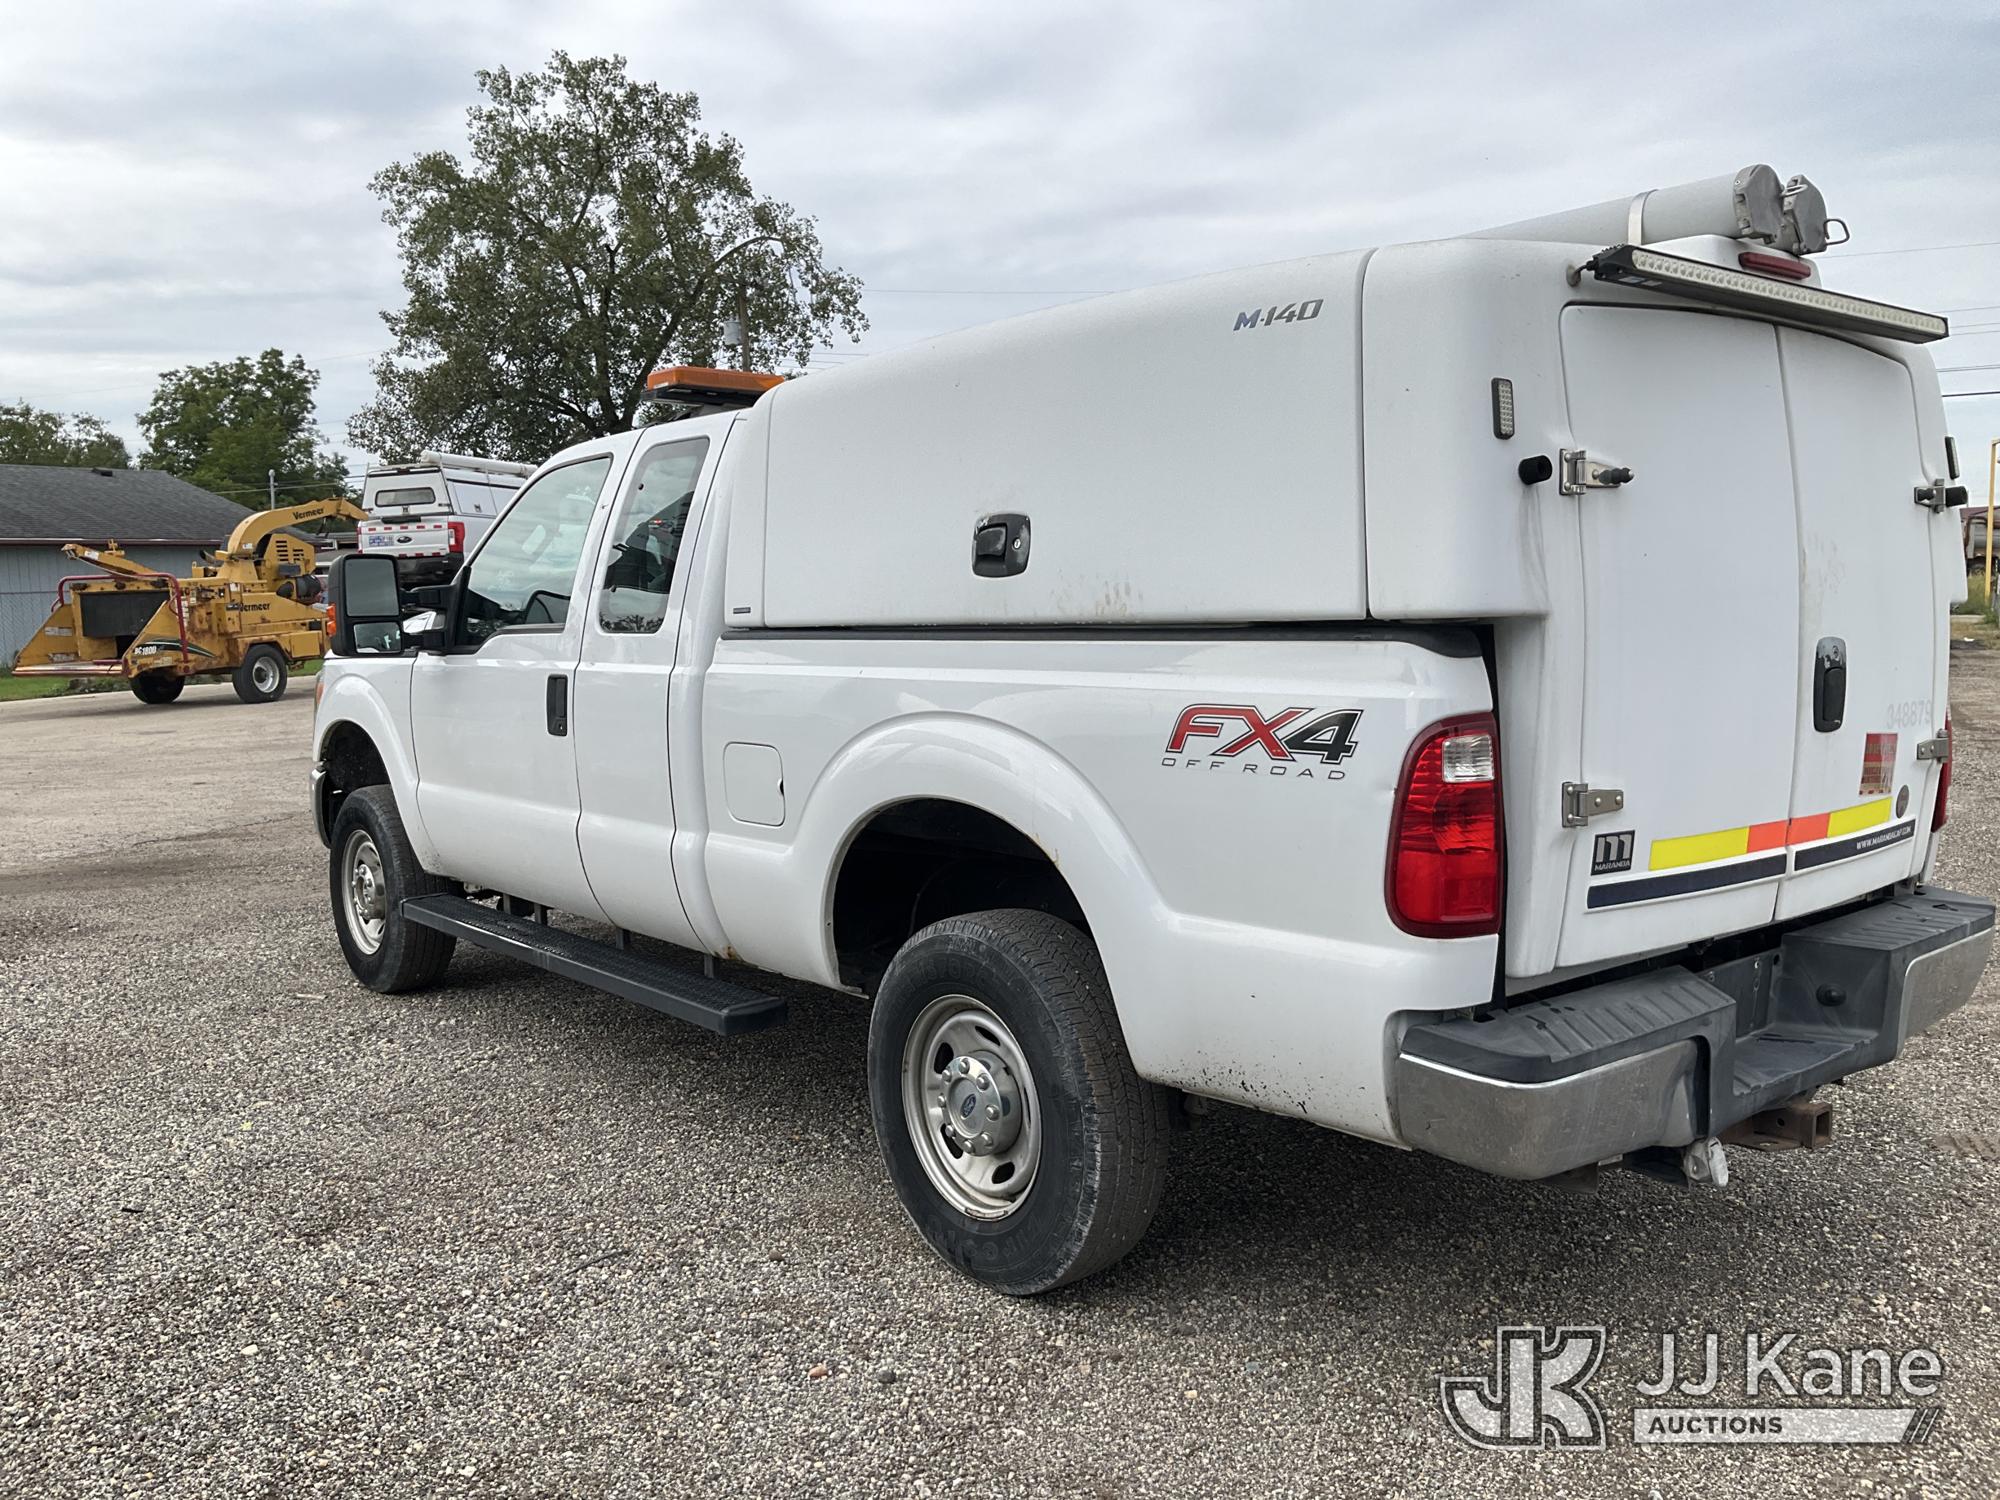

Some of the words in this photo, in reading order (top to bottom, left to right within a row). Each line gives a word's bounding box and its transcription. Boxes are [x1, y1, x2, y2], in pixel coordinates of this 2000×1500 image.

[292, 507, 325, 520] Vermeer
[1165, 703, 1364, 764] FX4
[1161, 757, 1225, 771] OFF
[1242, 763, 1347, 781] ROAD
[1594, 860, 1630, 871] MARANDA
